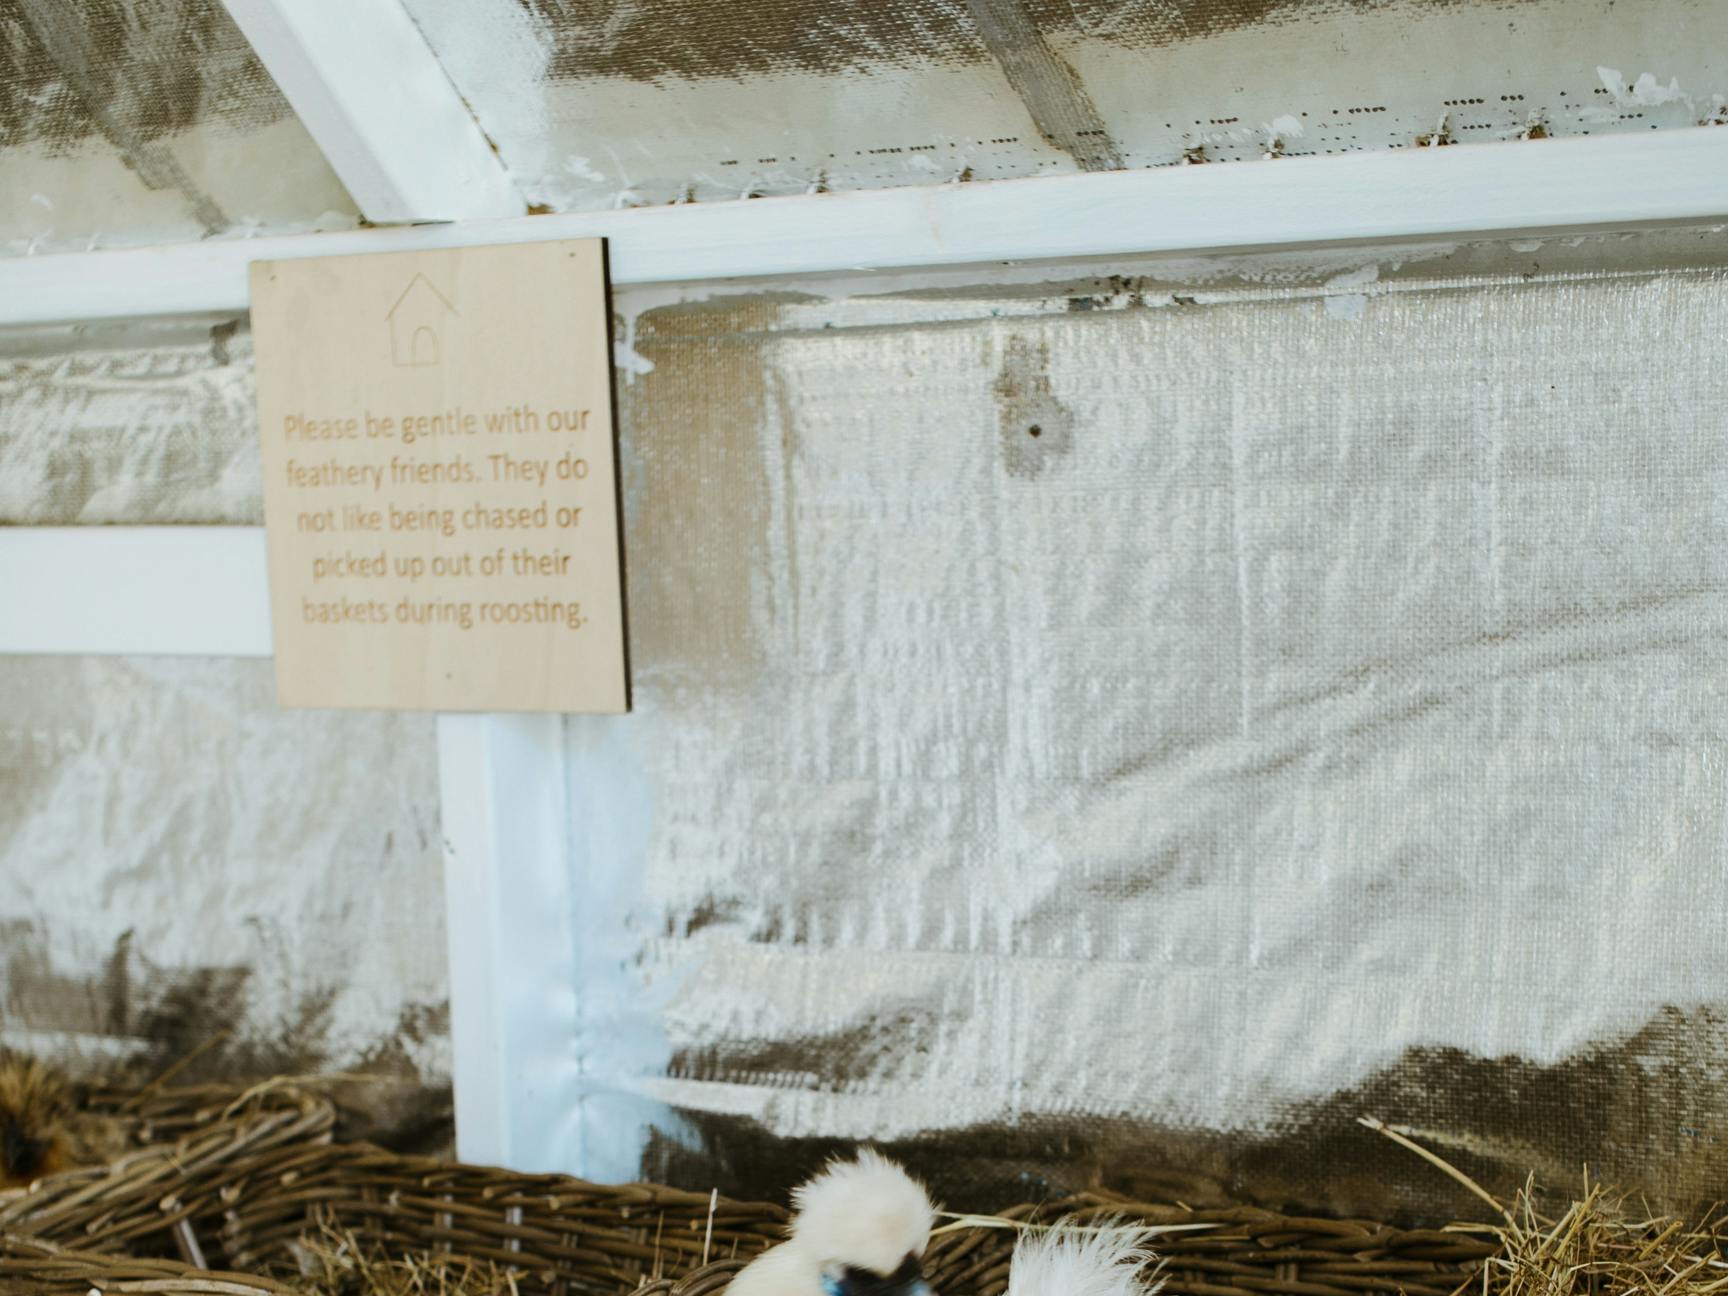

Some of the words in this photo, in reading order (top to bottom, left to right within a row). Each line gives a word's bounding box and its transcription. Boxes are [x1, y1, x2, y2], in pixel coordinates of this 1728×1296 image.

[284, 413, 358, 441] Please
[366, 410, 394, 438] be
[401, 406, 477, 444] gentle
[484, 404, 540, 433] with
[546, 408, 590, 432] our
[286, 459, 384, 490] feathery
[390, 455, 481, 484] friends.
[487, 453, 549, 487] They
[556, 451, 589, 480] do
[297, 510, 335, 531] not
[342, 504, 382, 532] like
[389, 503, 455, 536] being
[461, 500, 547, 529] chased
[556, 505, 582, 528] or
[312, 550, 387, 582] picked
[394, 555, 424, 582] up
[431, 552, 471, 577] out
[479, 548, 505, 576] of
[511, 548, 572, 576] their
[302, 597, 389, 624] baskets
[395, 596, 472, 630] during
[479, 596, 588, 630] roosting.
